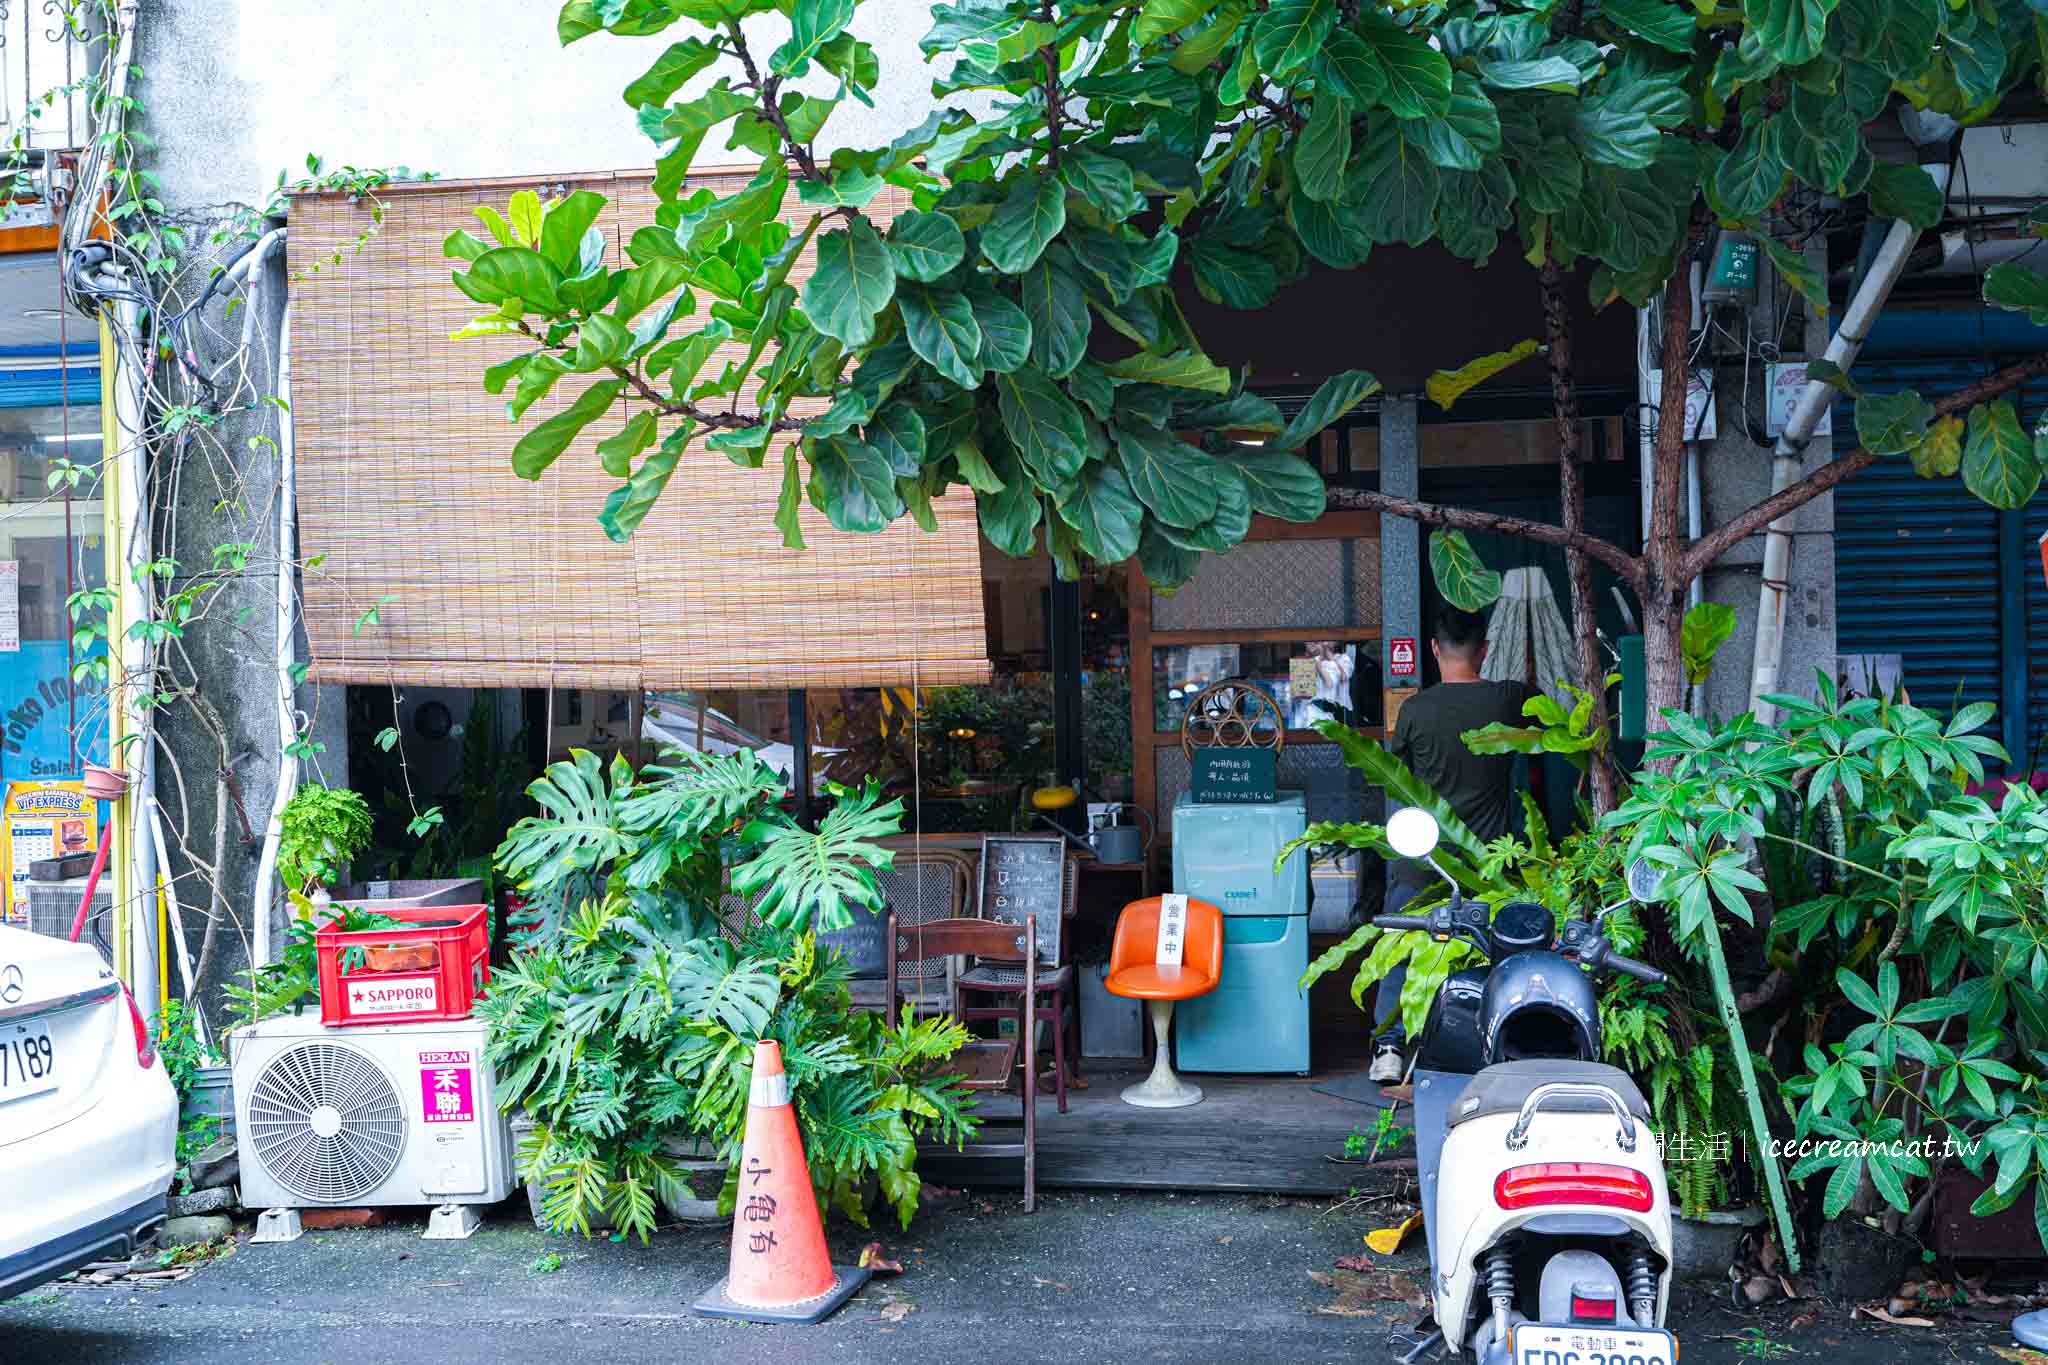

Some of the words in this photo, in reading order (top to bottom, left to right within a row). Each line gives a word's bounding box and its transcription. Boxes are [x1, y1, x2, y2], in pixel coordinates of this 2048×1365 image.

[17, 799, 34, 810] VIP
[36, 797, 81, 810] EXPRESS
[1164, 903, 1179, 955] 營業中
[367, 986, 433, 1003] SAPPORO
[0, 1034, 53, 1087] 7189
[420, 1052, 469, 1063] HERAN
[432, 1069, 461, 1114] 禾聯
[1570, 1335, 1617, 1351] 電動車
